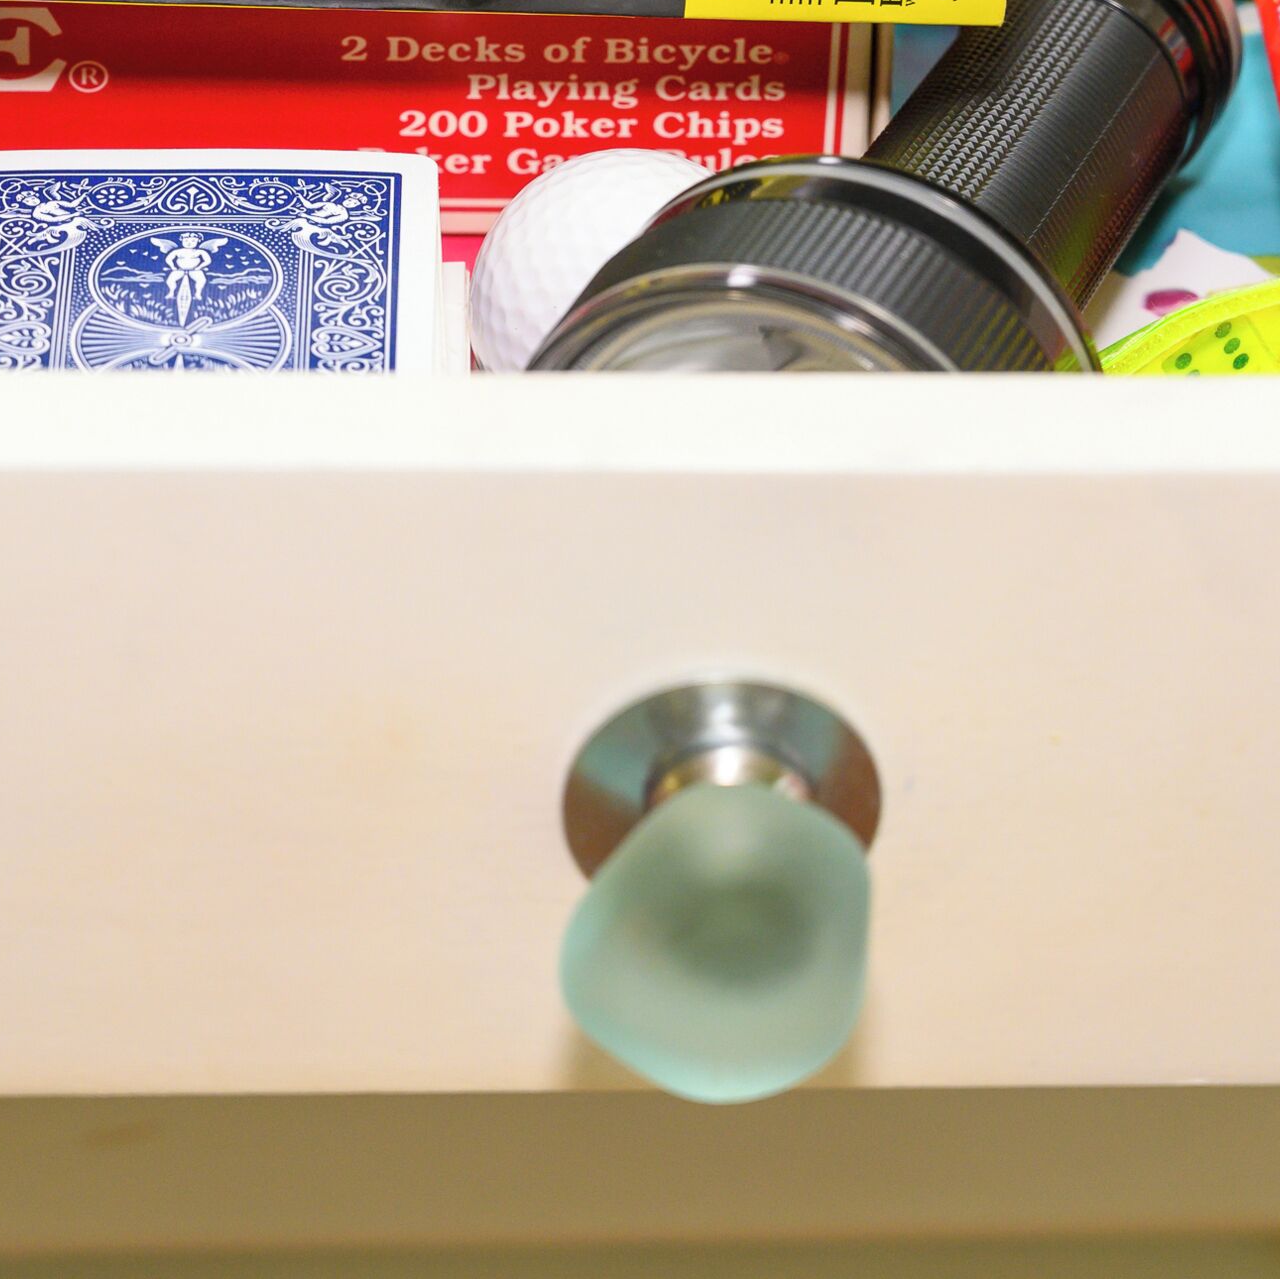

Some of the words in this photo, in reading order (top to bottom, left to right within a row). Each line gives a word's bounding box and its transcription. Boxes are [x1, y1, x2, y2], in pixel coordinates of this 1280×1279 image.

[340, 36, 369, 62] 2
[386, 35, 526, 63] Decks
[543, 36, 592, 63] of
[466, 74, 639, 108] Playing
[654, 74, 786, 102] Cards
[397, 110, 489, 138] 200
[503, 110, 639, 138] Poker
[653, 109, 785, 145] Chips
